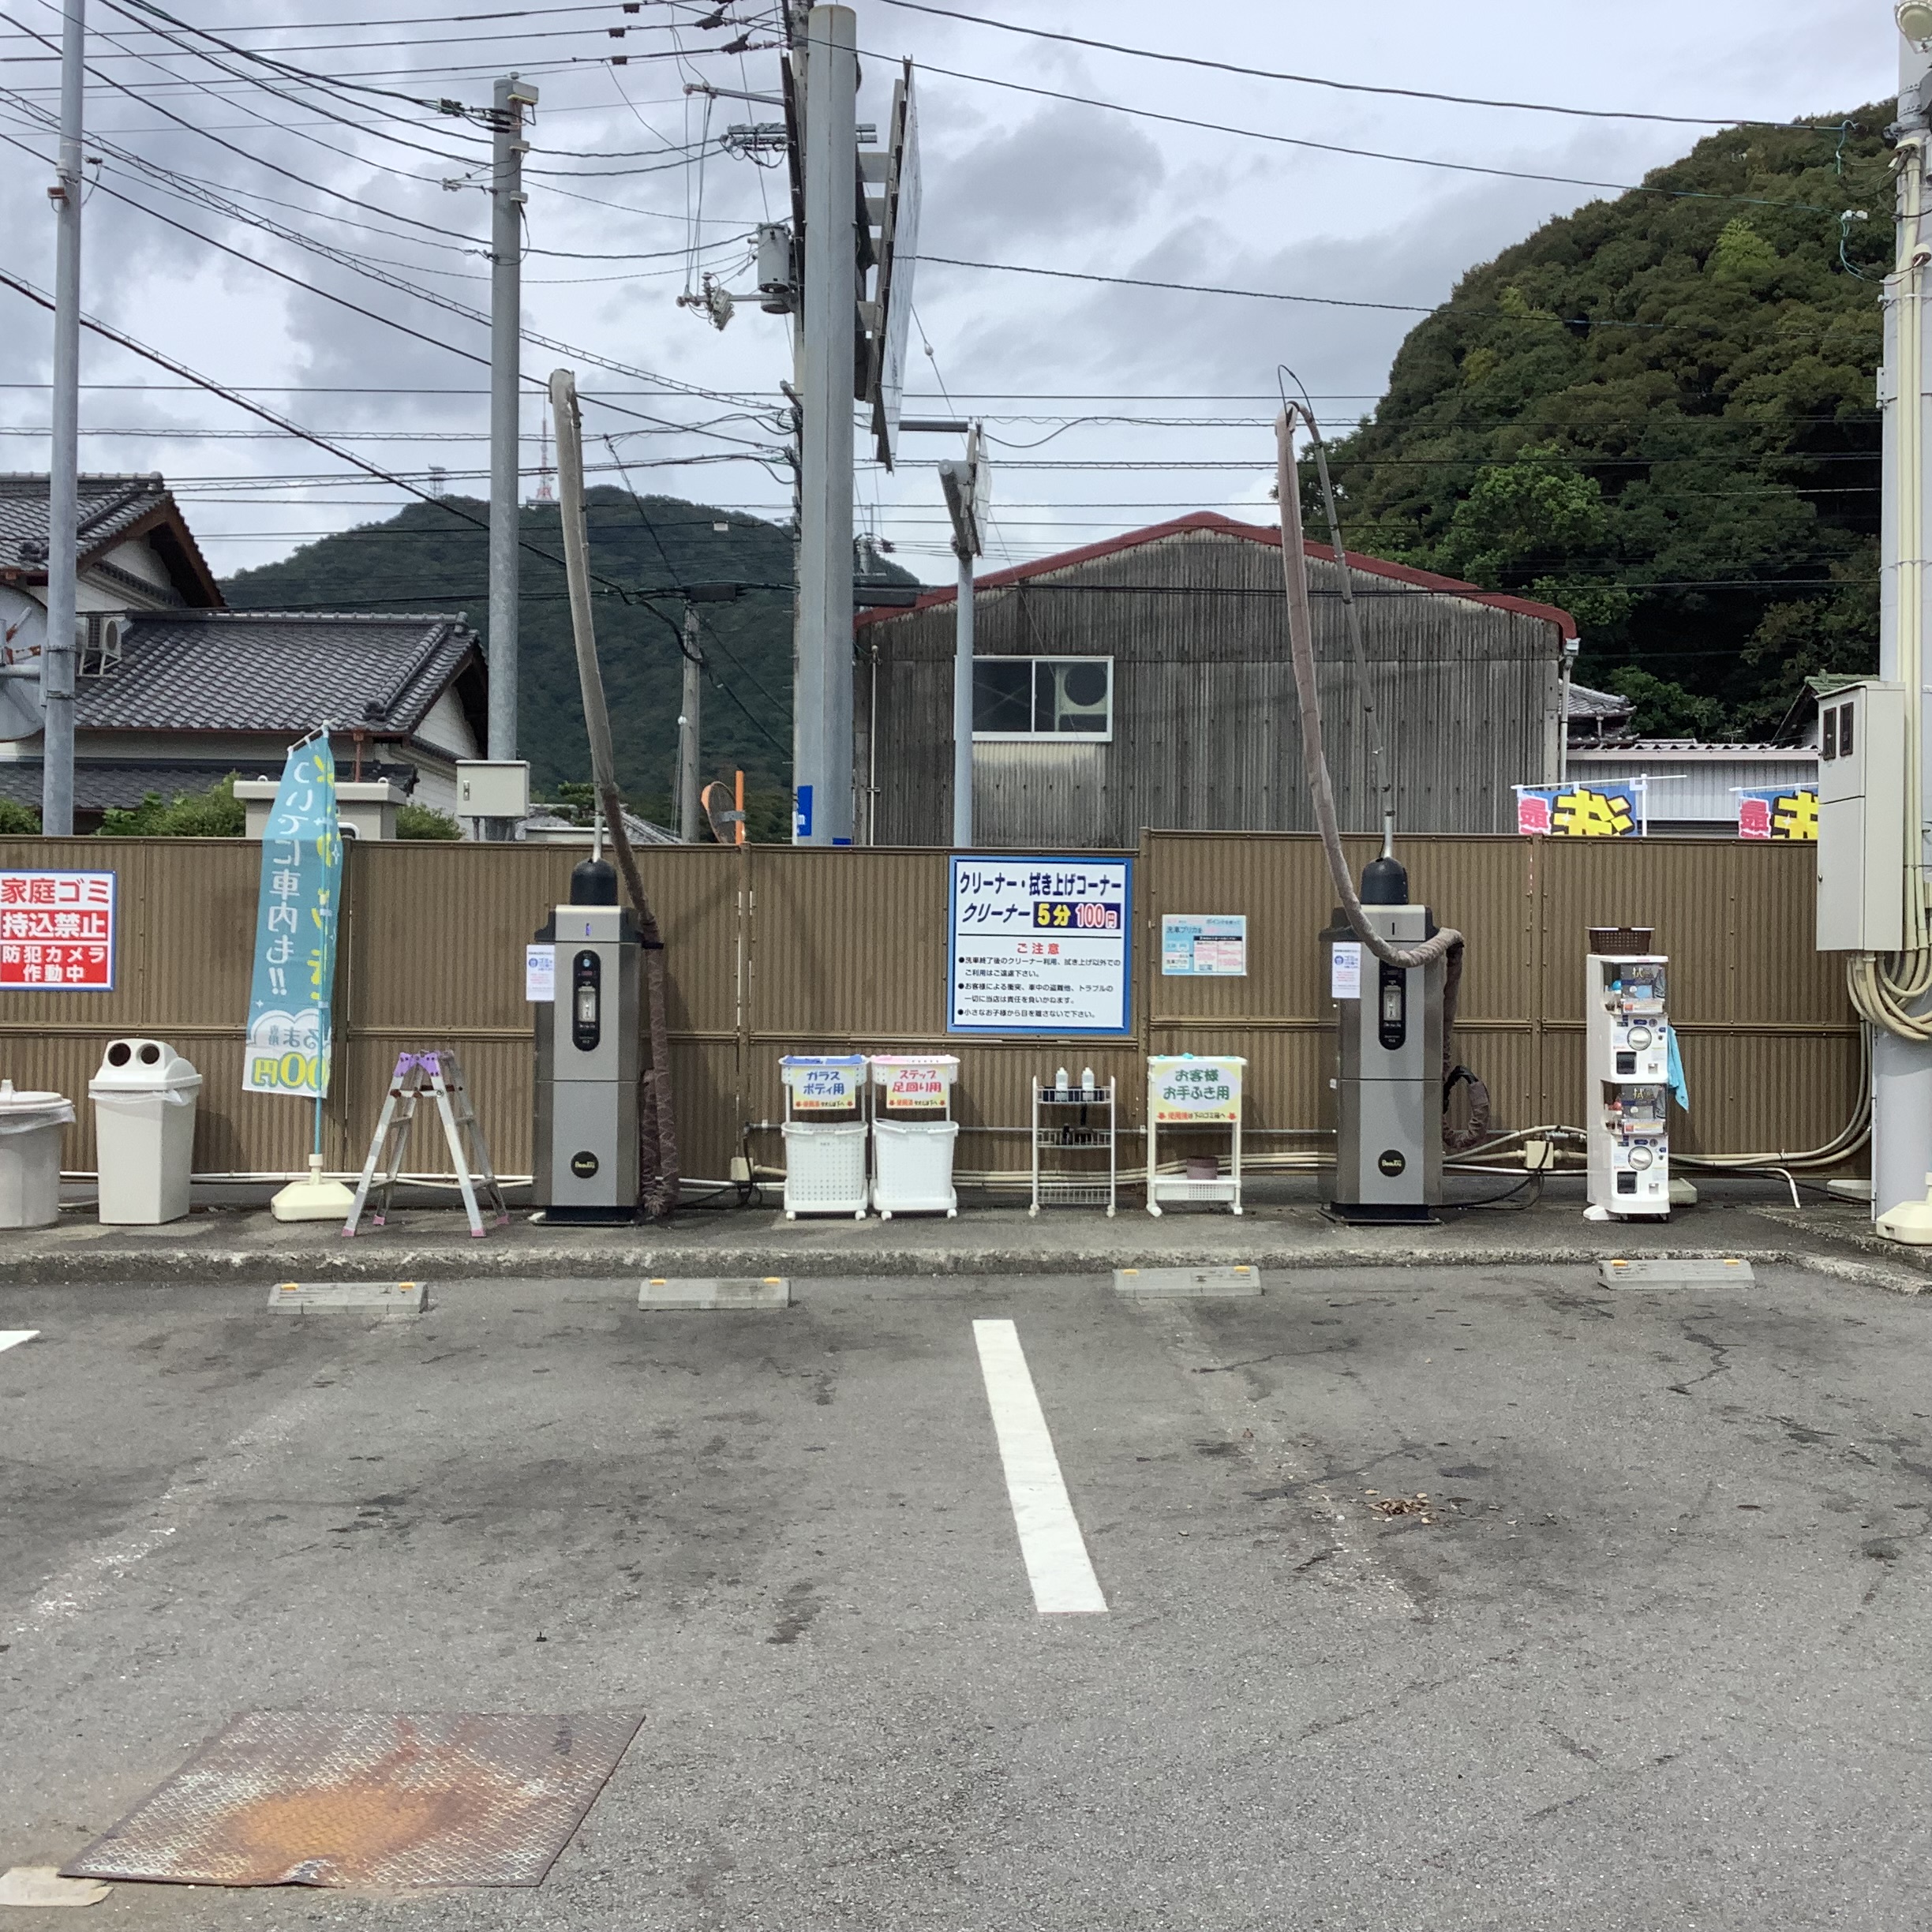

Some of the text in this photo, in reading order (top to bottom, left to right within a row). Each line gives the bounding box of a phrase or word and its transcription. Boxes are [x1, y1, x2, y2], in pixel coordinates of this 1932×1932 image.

[0, 878, 110, 904] 家庭ゴミ
[960, 871, 1122, 897] クリーナー・拭き上げコーナー
[961, 902, 1118, 930] クリーナー 5分 100円
[2, 912, 107, 938] 持込禁止
[2, 945, 106, 964] 防犯カメラ
[1017, 942, 1060, 955] ご注意
[23, 964, 84, 983] 作動中
[807, 1070, 841, 1082] ガラス
[899, 1069, 937, 1080] ステップ
[1174, 1069, 1219, 1082] お客様
[803, 1082, 845, 1095] ボディ用
[892, 1081, 942, 1094] 足回り用
[1163, 1085, 1230, 1101] お手ふき用
